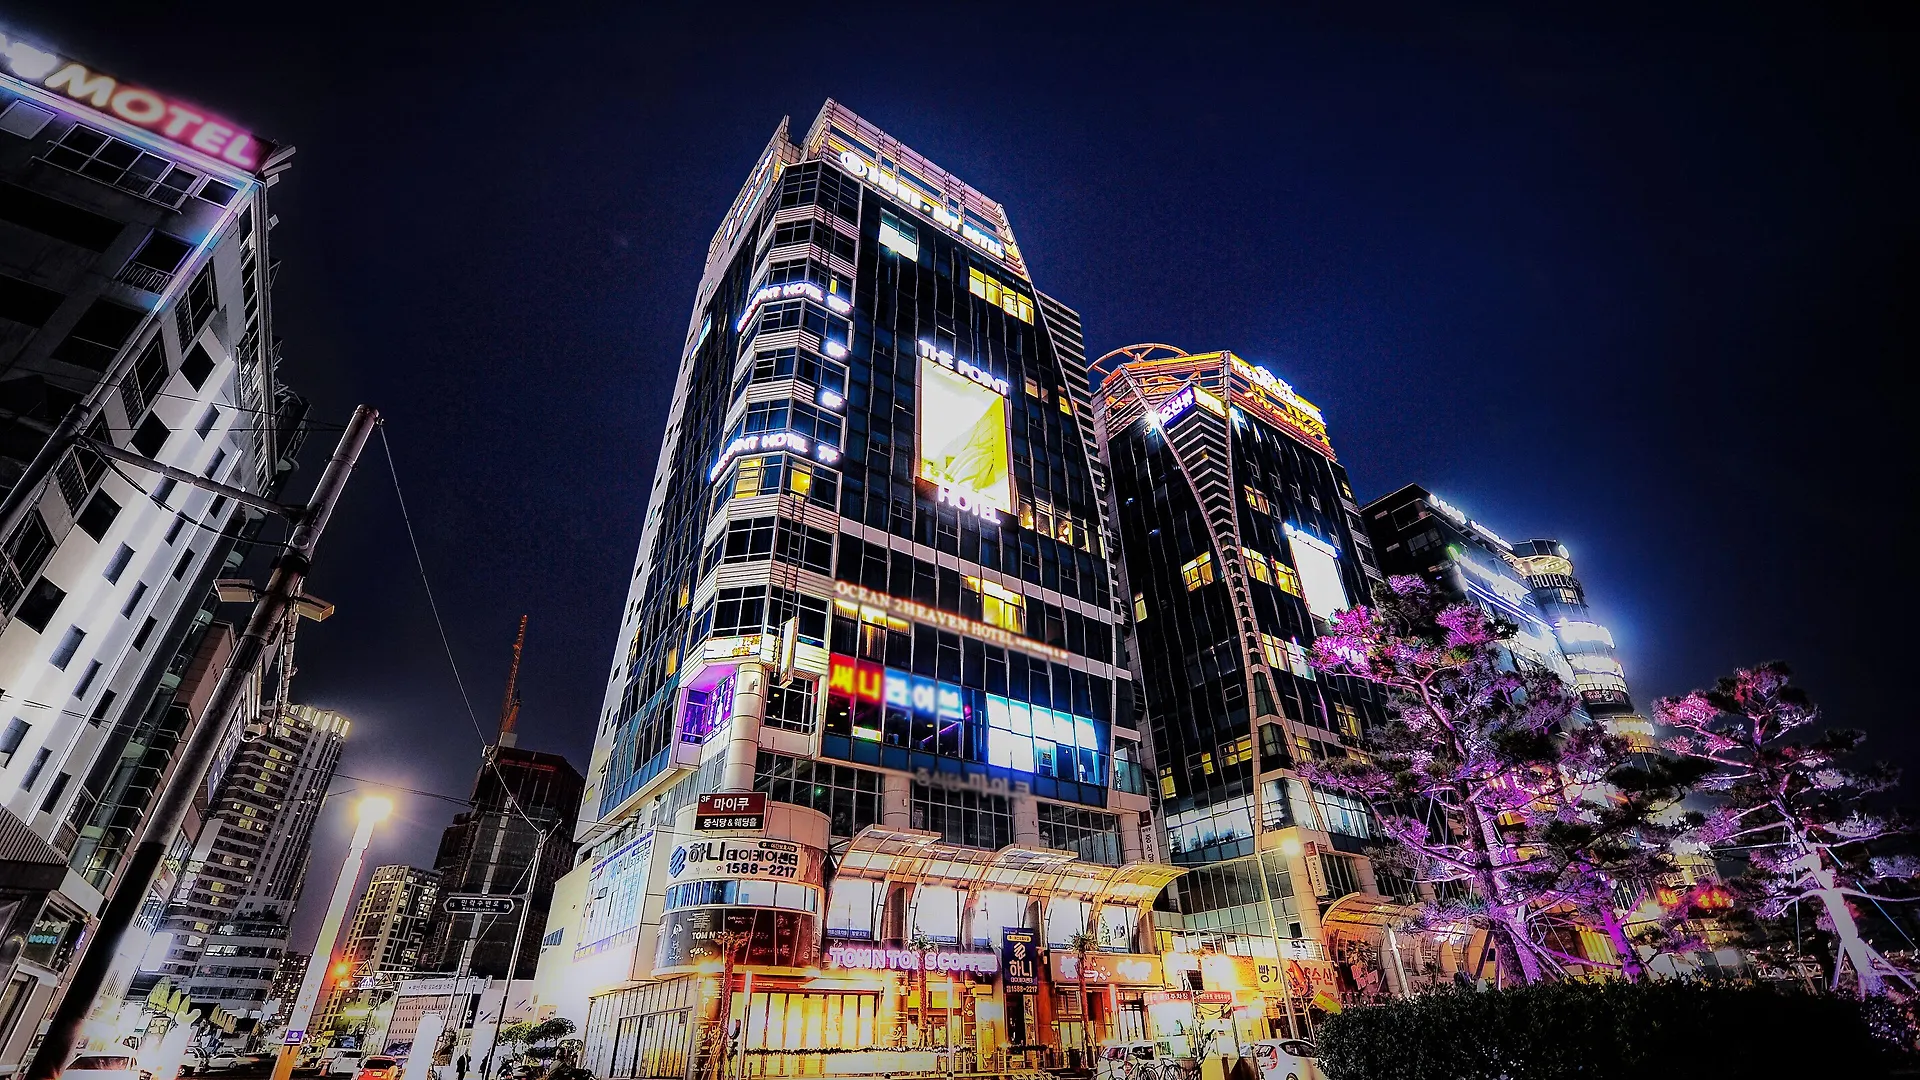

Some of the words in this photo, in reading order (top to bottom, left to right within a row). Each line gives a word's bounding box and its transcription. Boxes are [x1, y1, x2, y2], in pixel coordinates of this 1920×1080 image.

[44, 63, 254, 167] MOTEL
[918, 339, 954, 370] THE
[957, 359, 1009, 396] POINT
[936, 470, 1001, 525] HOTEL
[835, 580, 890, 608] OCEAN
[895, 598, 968, 633] 2HEAVEN
[972, 620, 1014, 646] HOTEL
[700, 795, 711, 803] 3F
[713, 797, 750, 811] 마이쿠
[725, 862, 797, 879] 1588-2217
[28, 934, 58, 945] HOTEL
[691, 931, 708, 940] TOM
[830, 947, 871, 968] TOM
[937, 951, 998, 972] COFFEE
[1009, 960, 1033, 977] 하니
[1312, 967, 1334, 985] 수산
